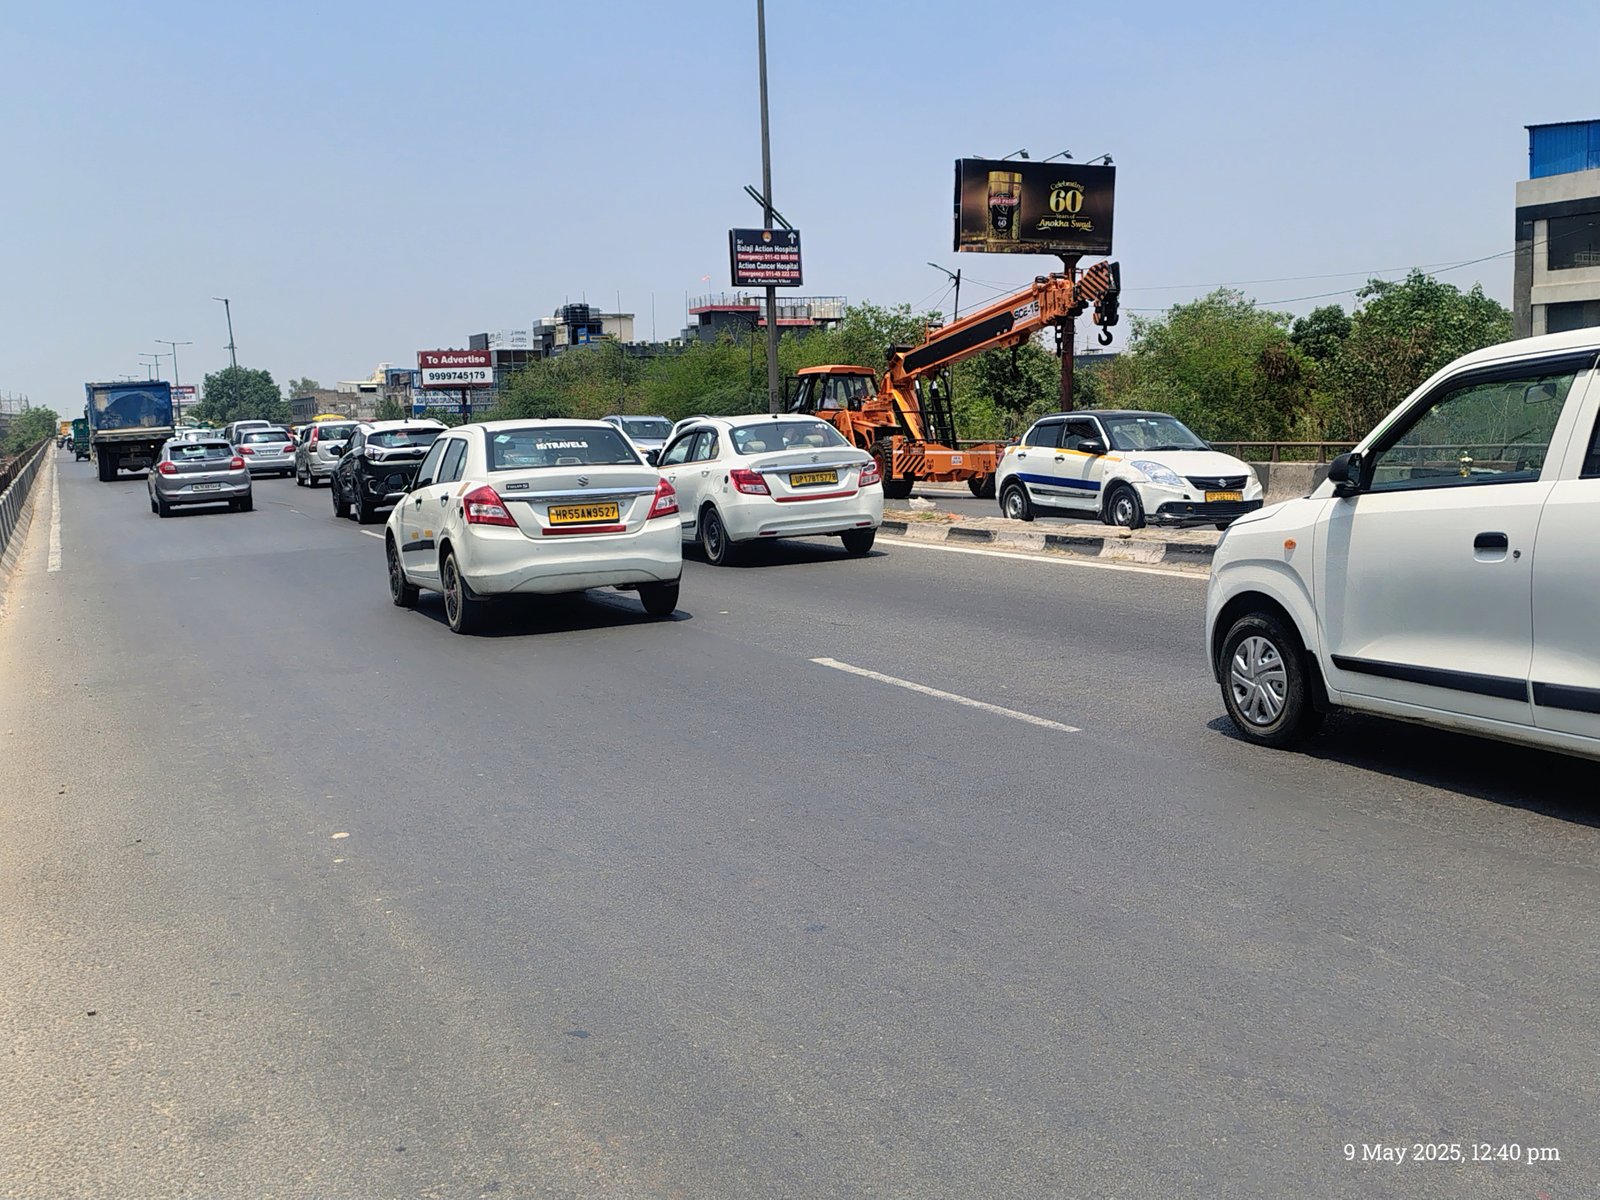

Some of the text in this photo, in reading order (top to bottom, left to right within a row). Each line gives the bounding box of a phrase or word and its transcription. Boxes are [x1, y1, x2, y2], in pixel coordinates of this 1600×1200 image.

[1050, 180, 1085, 192] Celebrating
[1049, 189, 1084, 213] 60
[1039, 219, 1092, 228] Anokha Swad
[737, 245, 753, 253] Balaji
[774, 245, 798, 254] Hospital
[776, 262, 798, 271] Hospital
[426, 355, 486, 364] To Advertise
[428, 371, 486, 380] 9999745179
